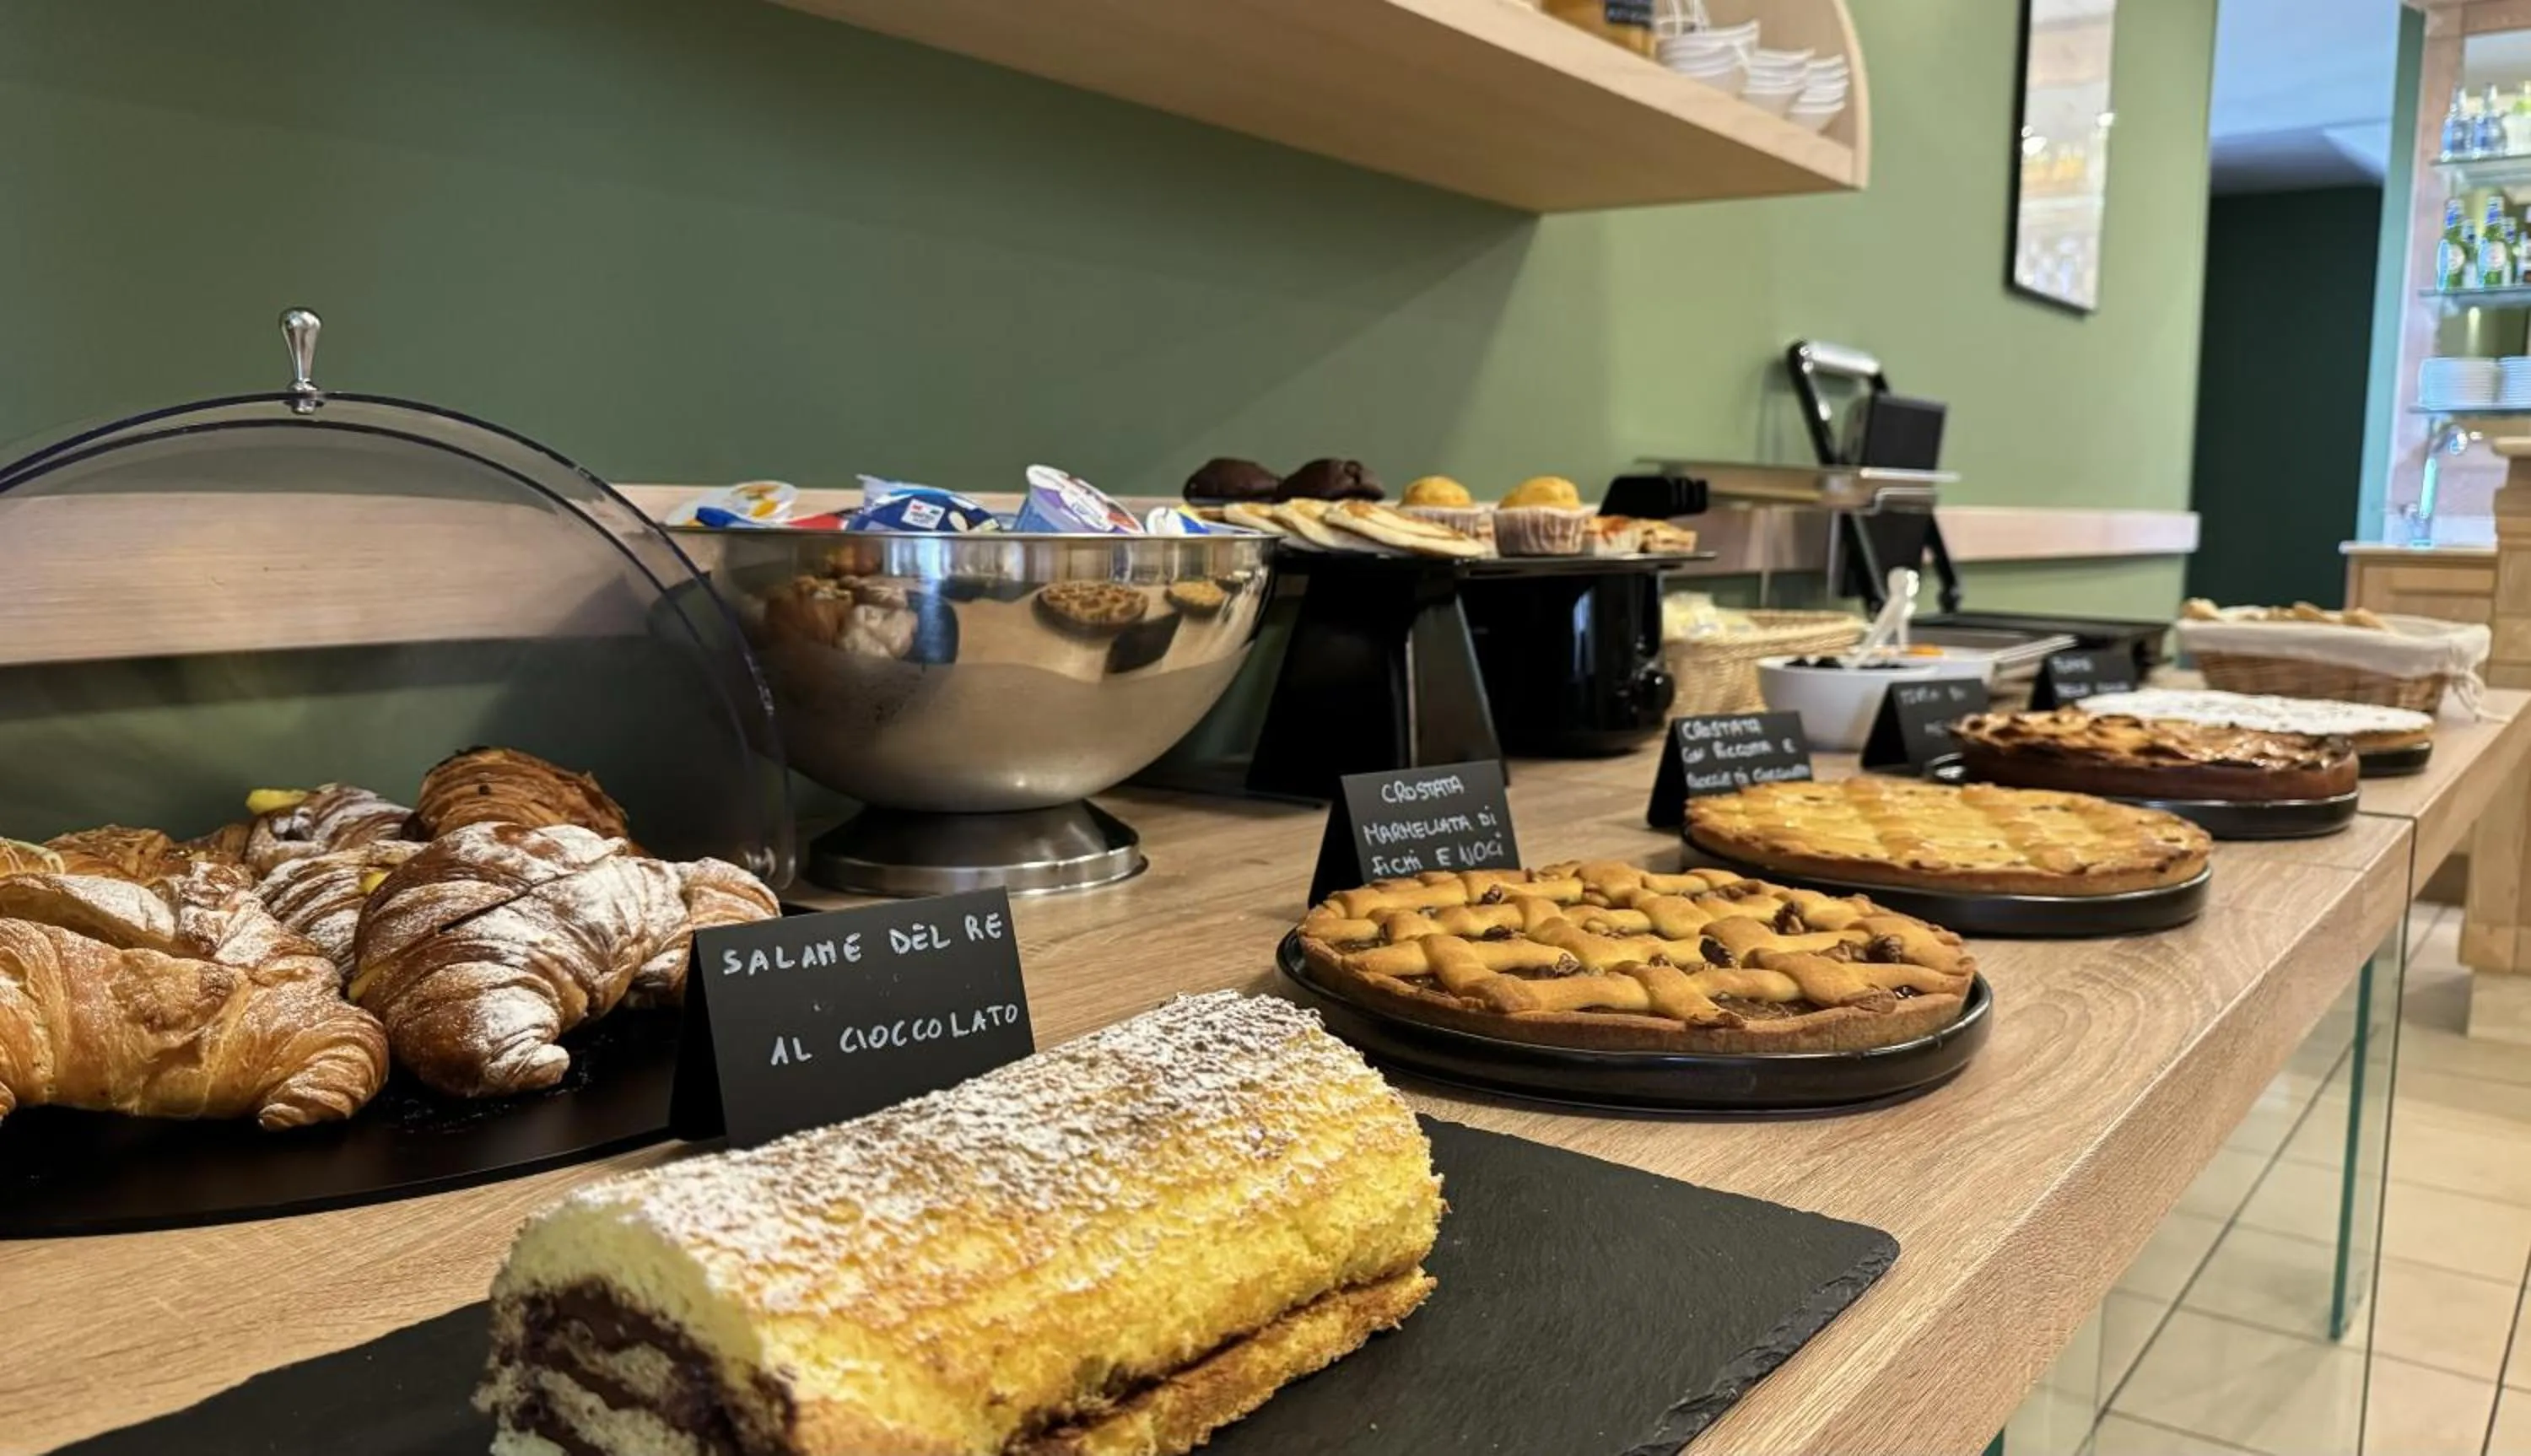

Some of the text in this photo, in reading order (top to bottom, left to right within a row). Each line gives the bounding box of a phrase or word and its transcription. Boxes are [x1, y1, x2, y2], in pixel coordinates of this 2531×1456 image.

[1681, 717, 1762, 741] CROSTATA
[1380, 774, 1465, 803] CROSTATA
[1363, 813, 1473, 845] MARMELLATA
[1435, 846, 1452, 867] E
[721, 932, 862, 975] SALAME
[963, 912, 1003, 941] RE
[770, 1004, 1019, 1066] AL CIOCCOLATO
